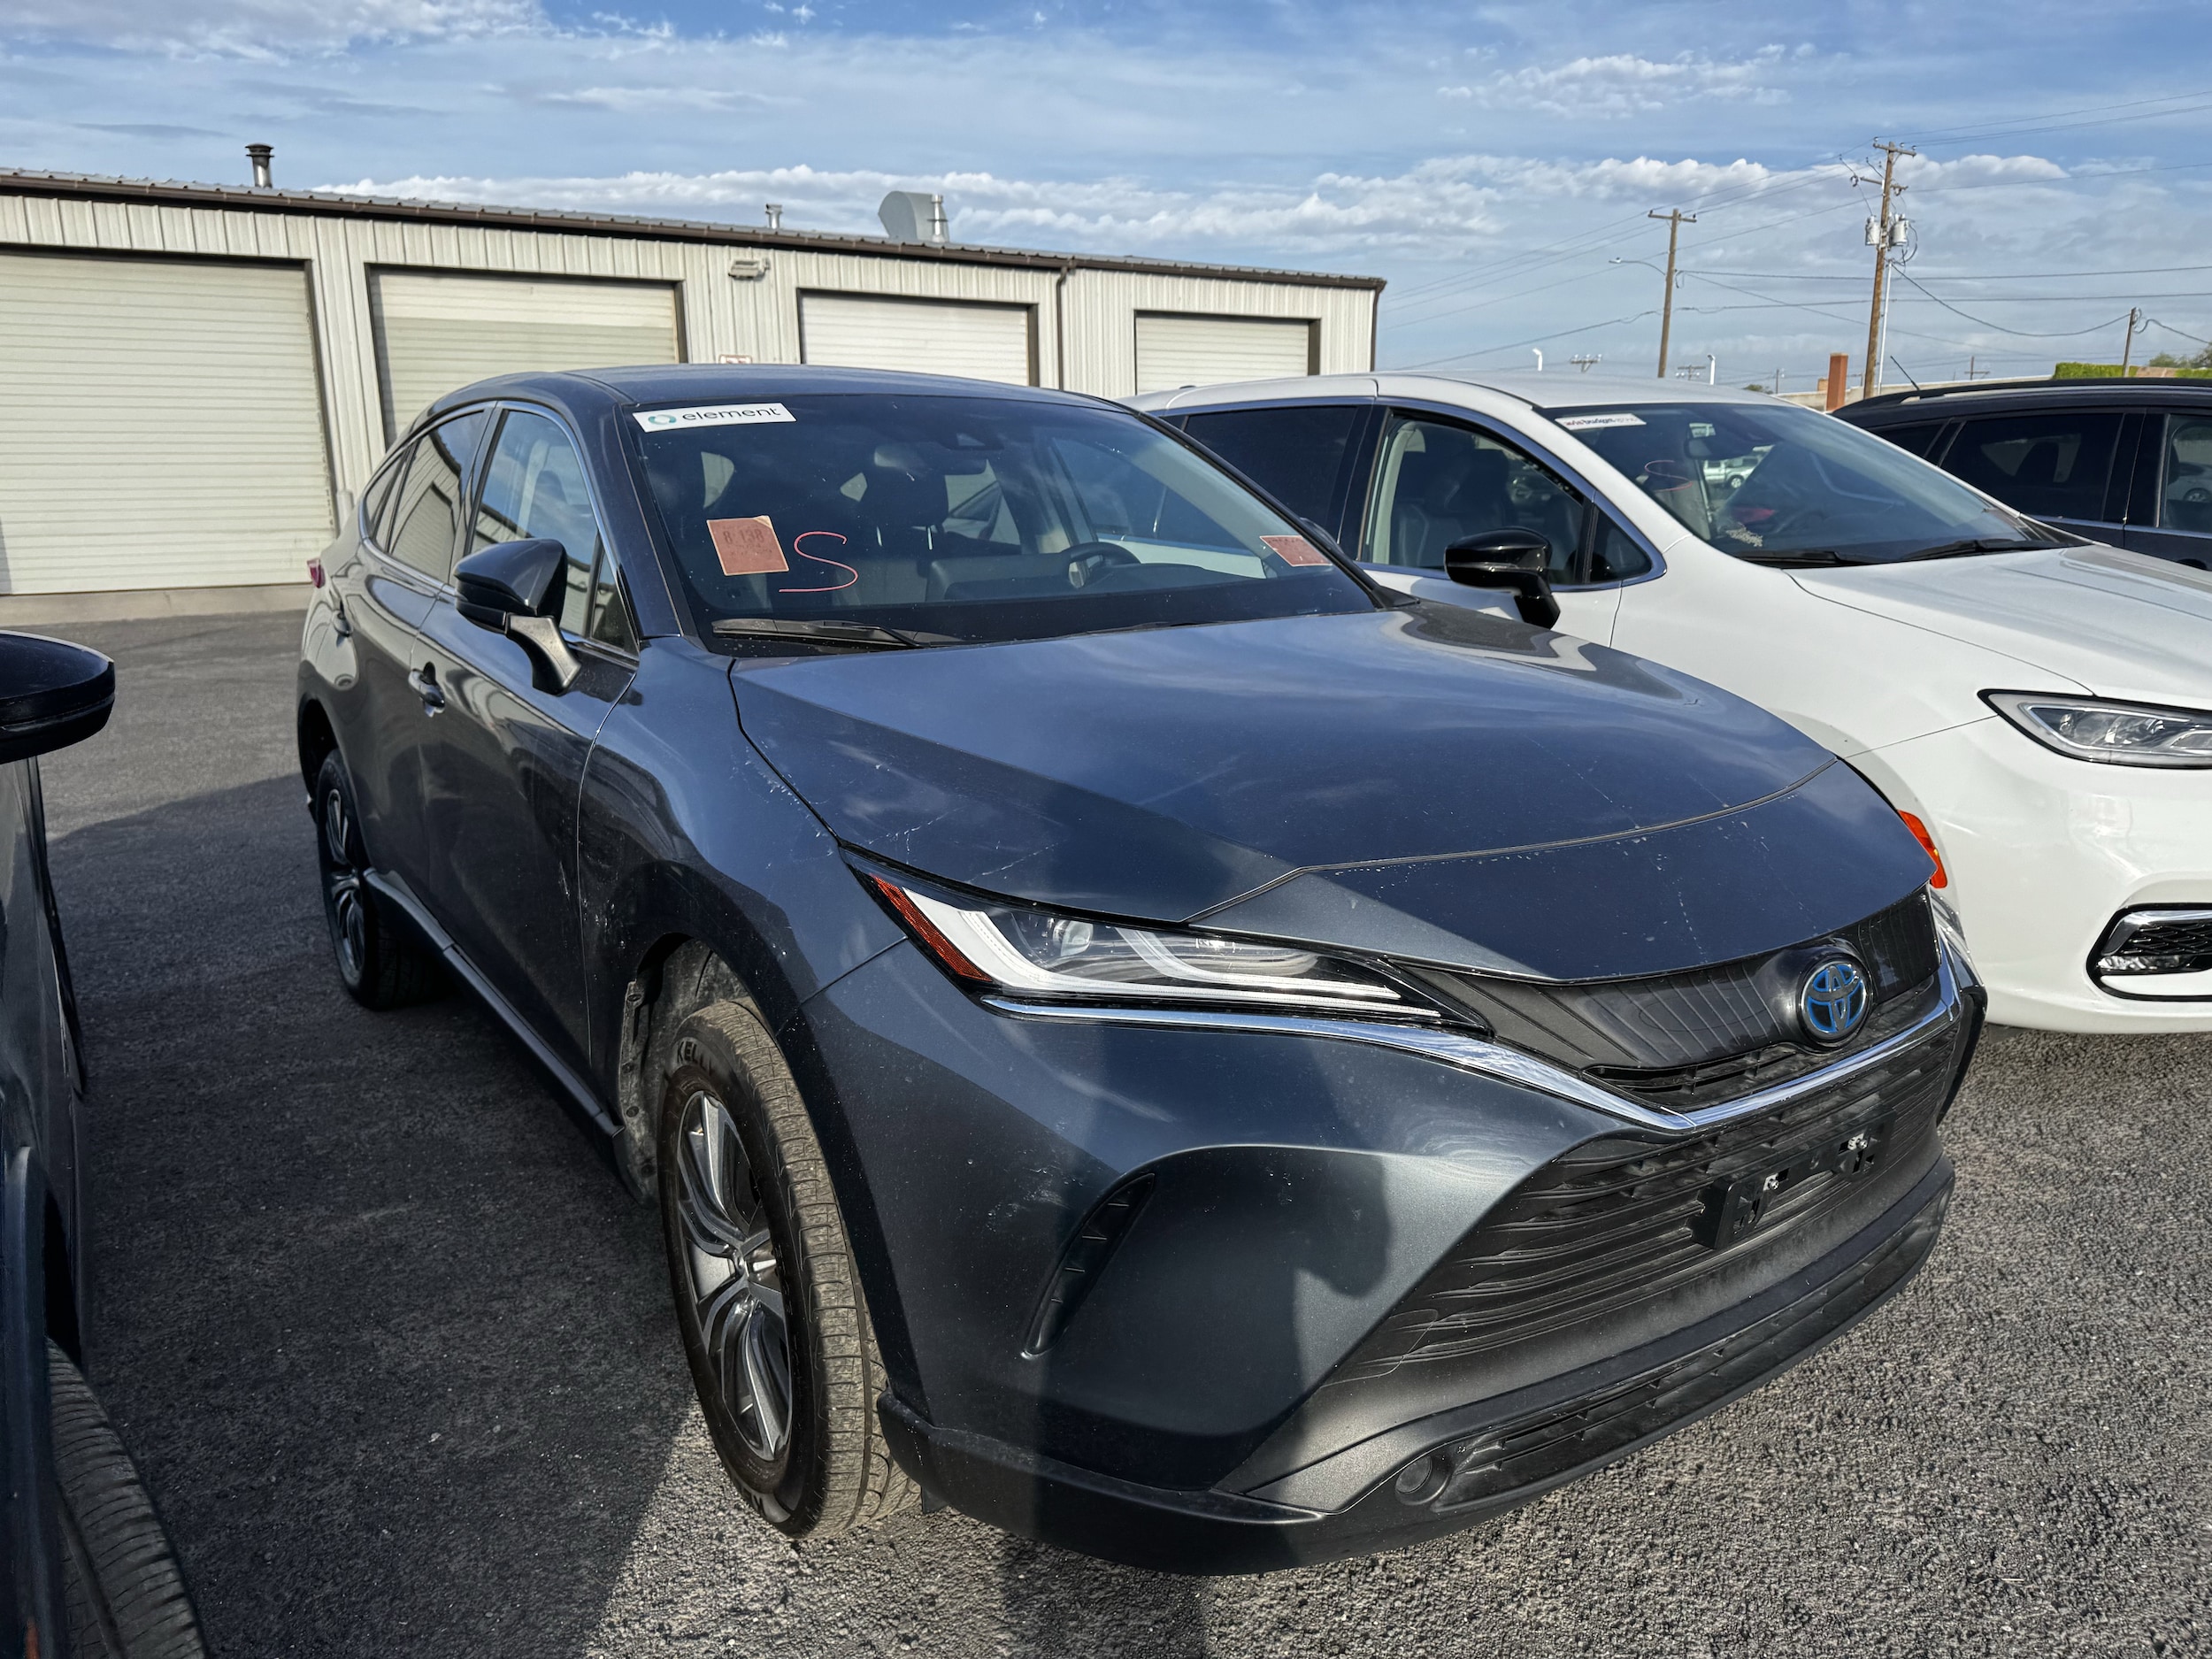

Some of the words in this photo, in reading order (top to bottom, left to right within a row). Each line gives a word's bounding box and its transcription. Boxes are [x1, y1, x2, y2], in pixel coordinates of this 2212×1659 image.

[681, 406, 781, 421] element
[1644, 459, 1694, 493] S
[778, 531, 858, 593] S
